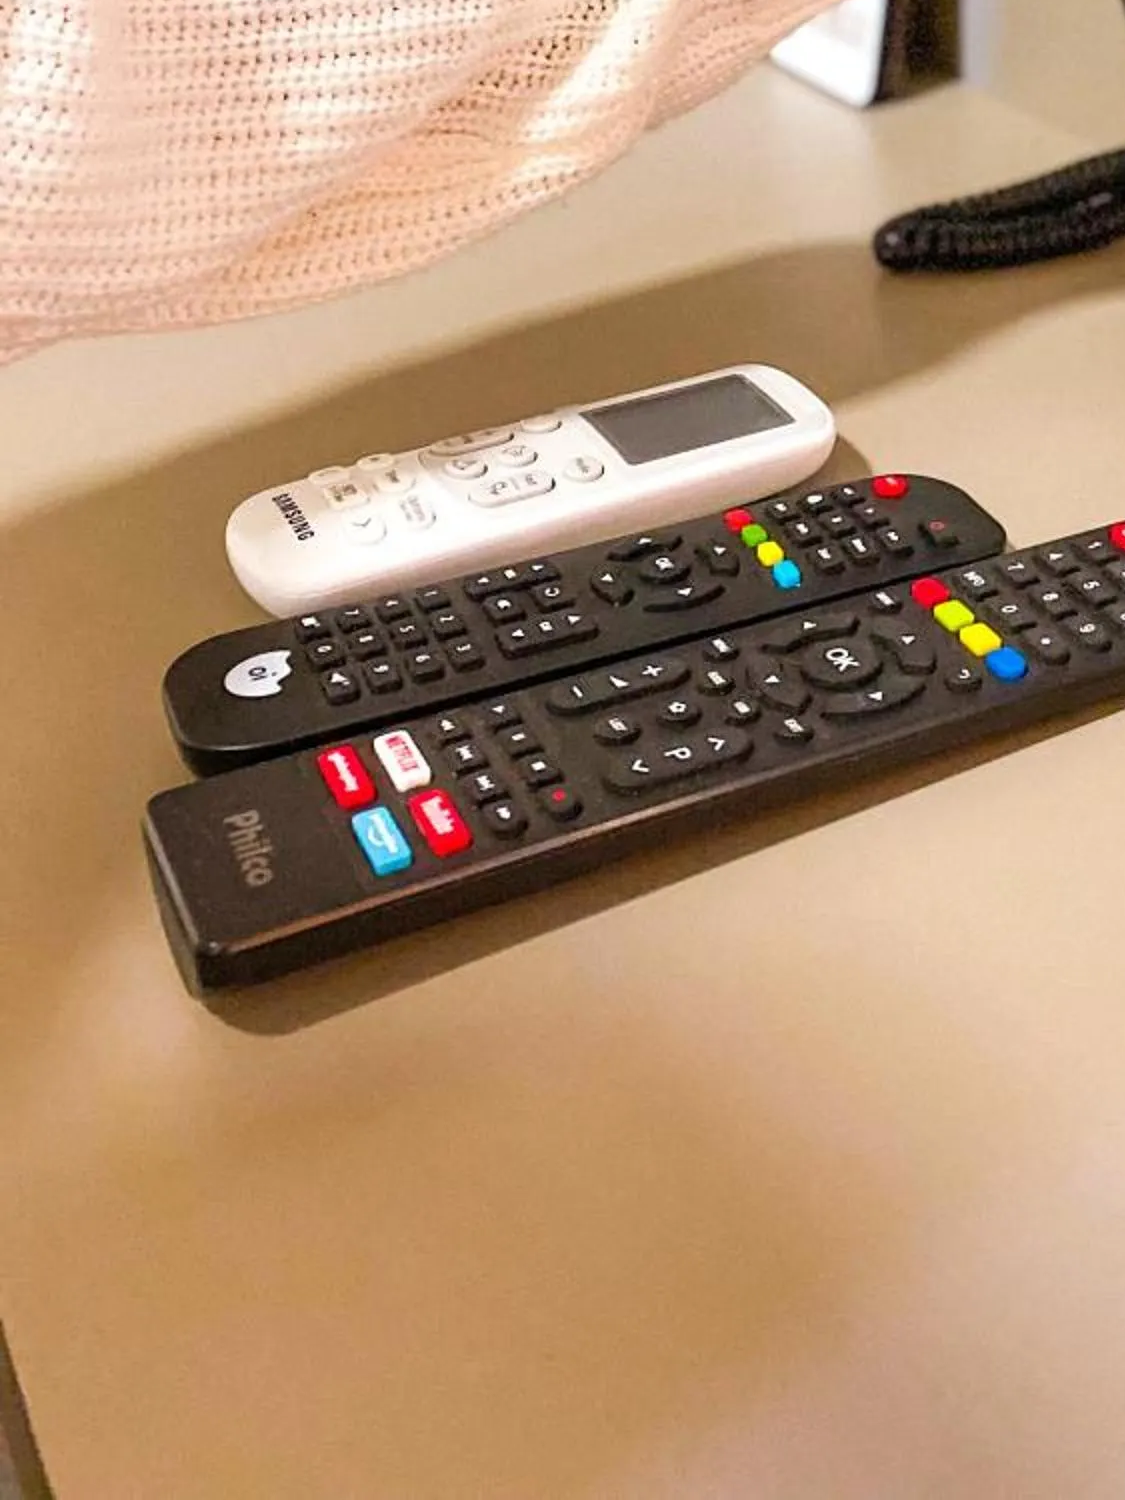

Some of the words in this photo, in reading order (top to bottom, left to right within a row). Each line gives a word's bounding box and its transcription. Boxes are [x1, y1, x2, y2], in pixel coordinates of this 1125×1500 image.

[272, 492, 315, 541] SAMSUNG
[1001, 604, 1018, 614] 0
[1079, 623, 1097, 634] 9
[825, 647, 860, 672] OK
[664, 747, 692, 760] P
[222, 809, 275, 888] Philco
